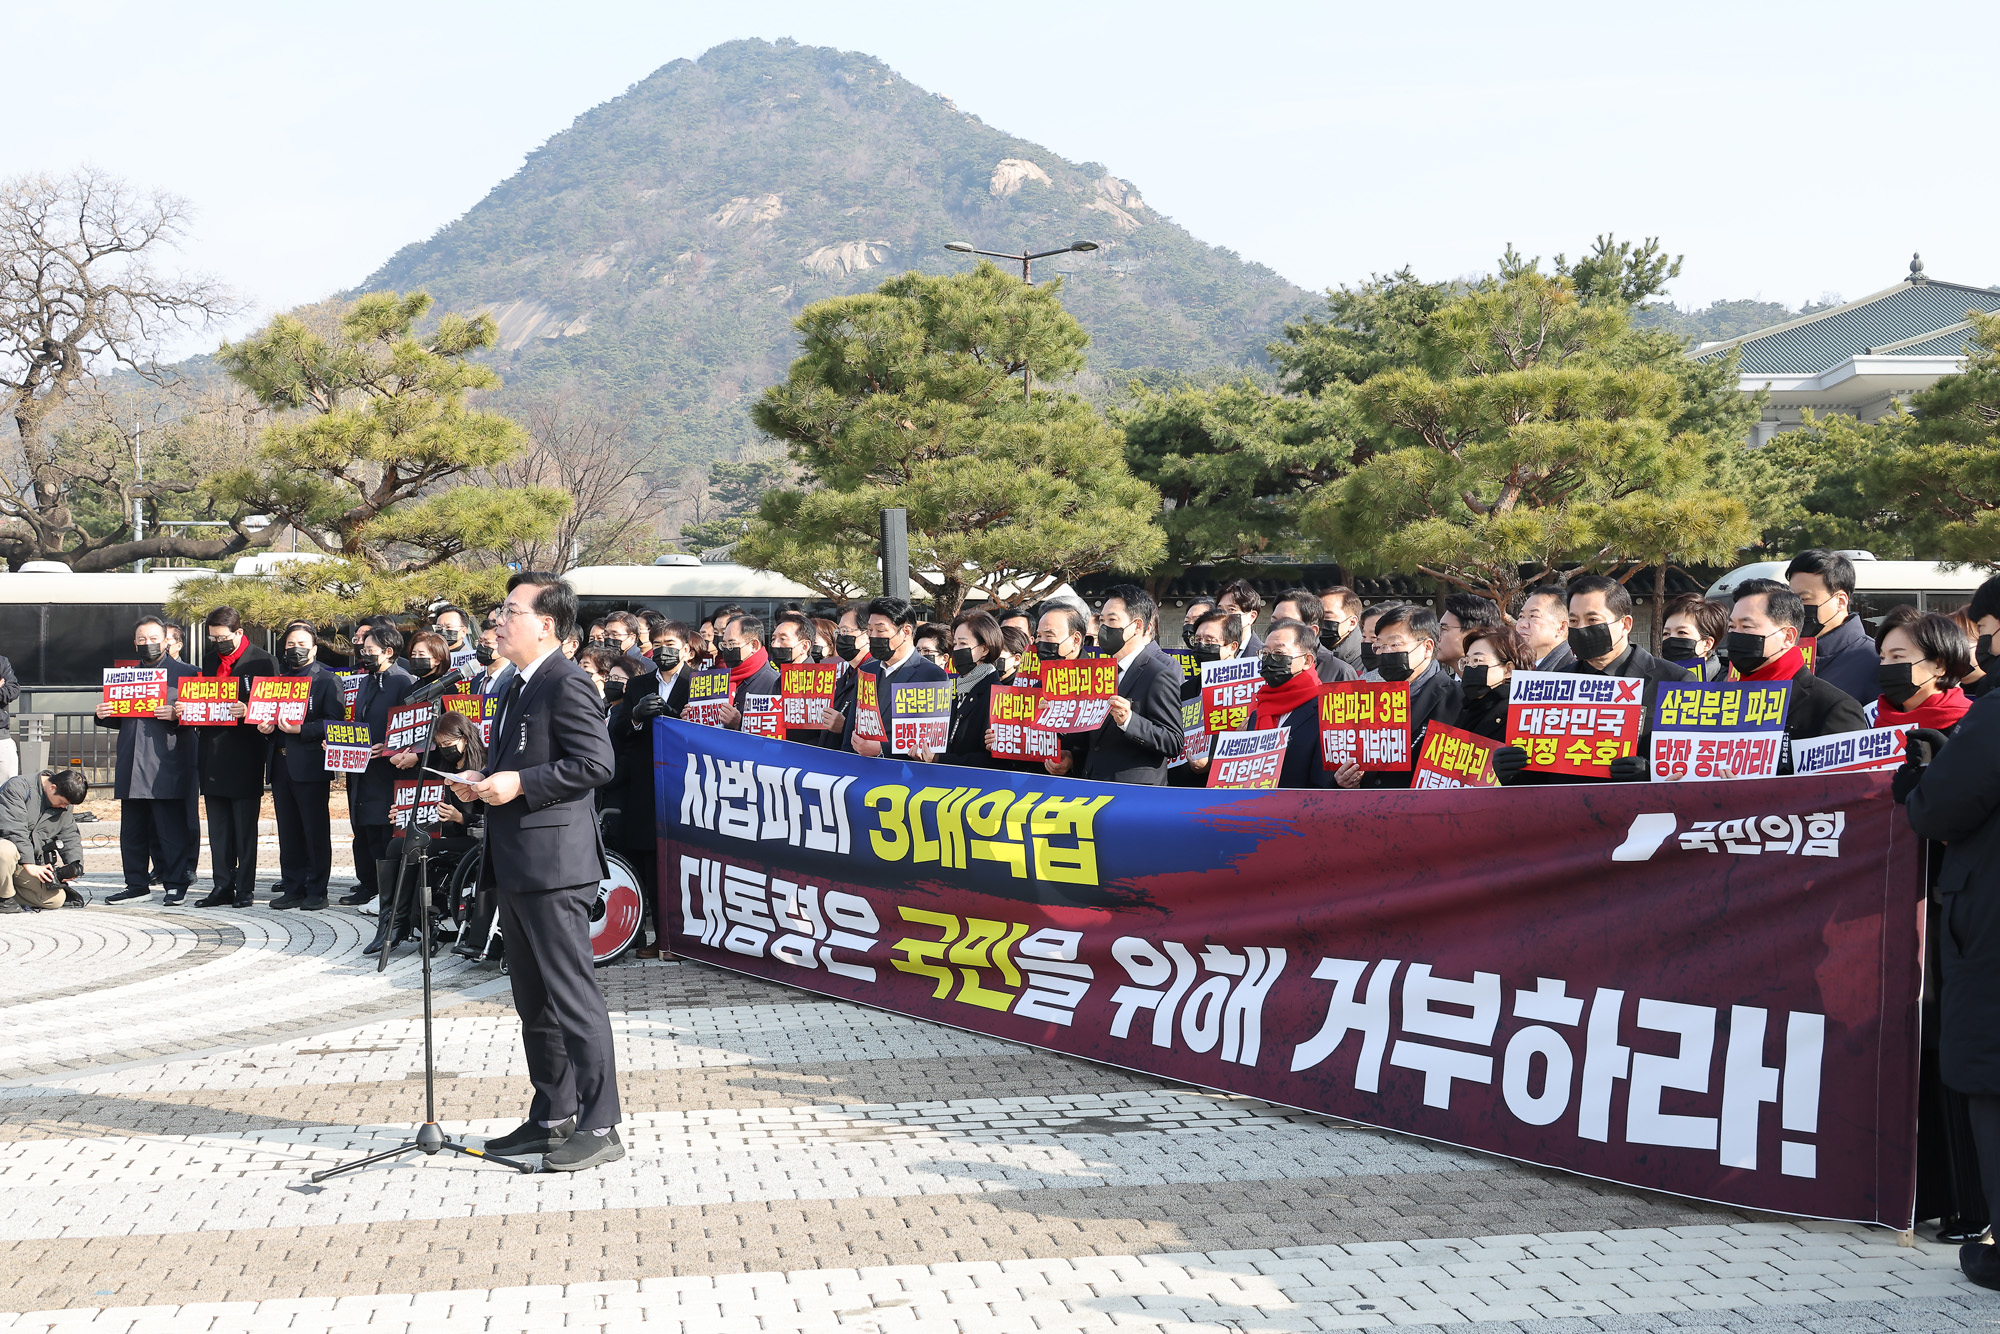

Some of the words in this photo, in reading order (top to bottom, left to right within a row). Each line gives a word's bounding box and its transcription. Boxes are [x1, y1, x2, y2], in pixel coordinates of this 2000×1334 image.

[105, 671, 135, 683] 사법파괴
[137, 671, 153, 681] 악법
[689, 674, 712, 698] 삼권분립
[713, 673, 729, 695] 파괴
[784, 670, 815, 694] 사법파괴
[816, 670, 835, 694] 3법
[1046, 667, 1091, 696] 사법파괴
[1095, 666, 1115, 694] 3법
[1205, 661, 1254, 685] 사법파괴
[109, 684, 160, 699] 대한민국
[181, 681, 219, 699] 사법파괴
[220, 681, 237, 699] 3법
[253, 681, 292, 699] 사법파괴
[292, 681, 309, 699] 3법
[864, 680, 877, 707] 3법
[895, 688, 935, 713] 삼권분립
[936, 686, 951, 712] 파괴
[1213, 681, 1267, 706] 대한
[1513, 679, 1576, 702] 사법파괴
[1579, 680, 1614, 702] 악법
[208, 701, 236, 721] 거부하라
[249, 701, 277, 720] 대통령은
[278, 701, 305, 720] 거부하라!
[448, 699, 480, 719] 사법파괴
[752, 698, 769, 711] 악법
[784, 698, 805, 724] 대통령은
[992, 692, 1035, 722] 사법파괴
[1036, 699, 1077, 728] 대통령은
[1322, 691, 1374, 724] 사법파괴
[1379, 690, 1406, 723] 3법
[1660, 689, 1740, 726] 삼권분립
[1744, 687, 1787, 726] 파괴
[390, 709, 414, 730] 사법
[743, 715, 777, 733] 한민국
[1209, 706, 1248, 731] 헌정
[1519, 706, 1625, 737] 대한민국
[327, 724, 355, 744] 삼권분립
[355, 726, 370, 745] 파괴
[388, 729, 413, 750] 독재
[895, 723, 917, 749] 당장
[991, 723, 1021, 754] 대통령은
[1023, 726, 1057, 757] 거부하라!
[1217, 735, 1260, 757] 사법파괴
[1260, 732, 1278, 751] 악법
[1323, 729, 1356, 765] 대통령은
[1359, 728, 1406, 764] 거부하라!
[327, 748, 341, 768] 당장
[342, 749, 370, 769] 중단하라!
[1424, 733, 1490, 782] 사법파괴
[1656, 739, 1692, 777] 당장
[1695, 738, 1776, 777] 중단하라!
[1797, 740, 1855, 773] 사법파괴
[1859, 731, 1892, 759] 악법
[1218, 754, 1279, 783] 대한민국
[396, 787, 416, 806] 사법
[419, 785, 443, 802] 파괴
[416, 805, 440, 824] 완성
[679, 752, 858, 855] 사법파괴
[863, 784, 1115, 886] 3대악법
[1678, 811, 1845, 858] 국민의힘
[679, 855, 881, 983] 대통령은
[890, 905, 1095, 1027] 국민을
[1109, 935, 1288, 1067] 위해
[1290, 957, 1825, 1179] 거부하라!
